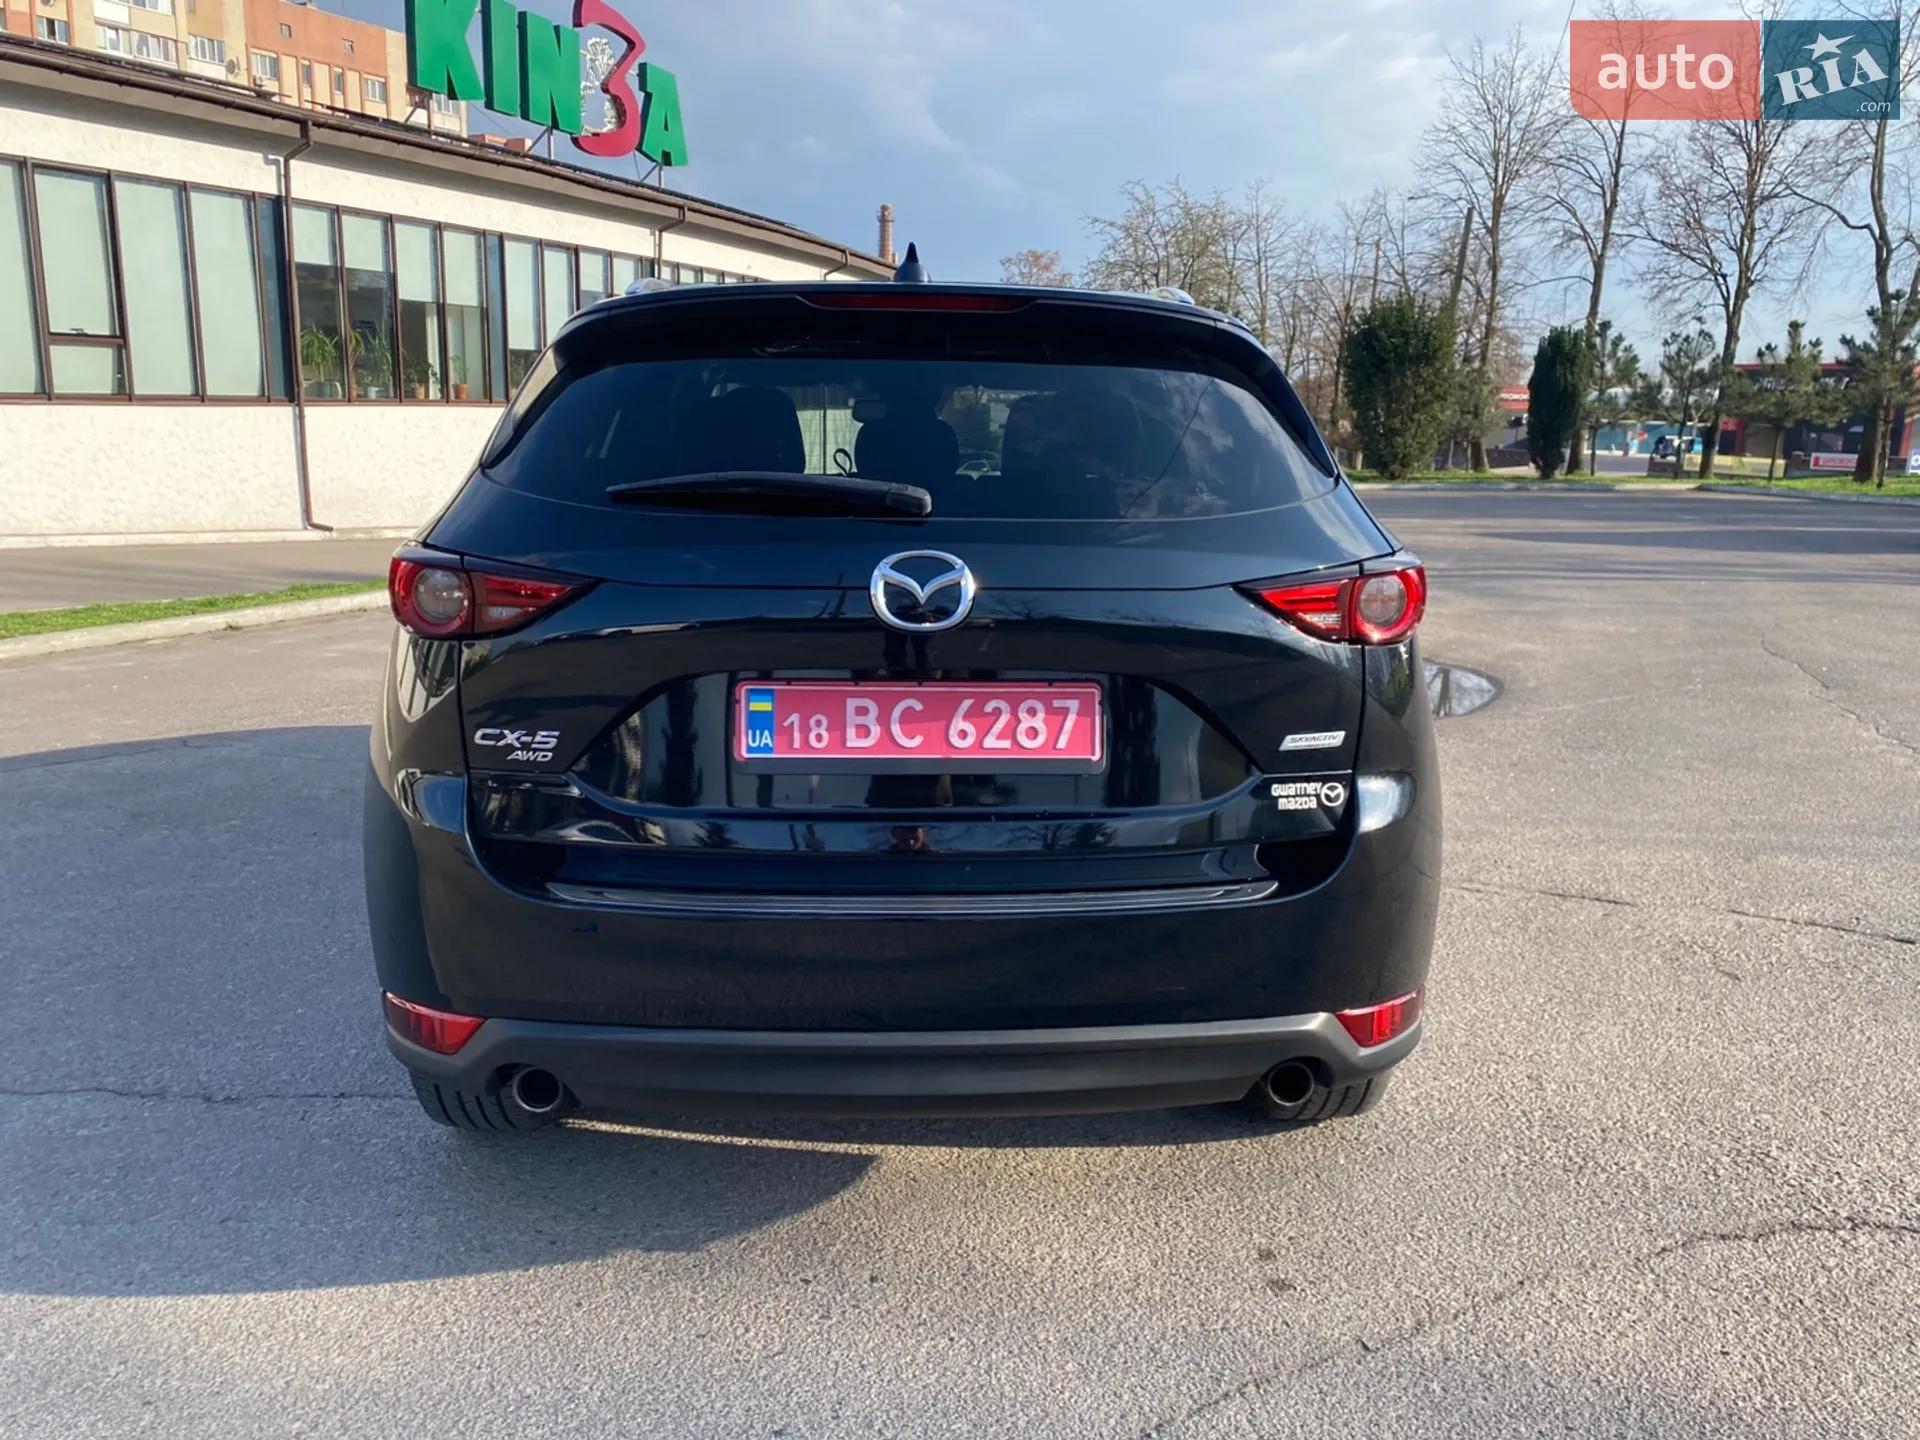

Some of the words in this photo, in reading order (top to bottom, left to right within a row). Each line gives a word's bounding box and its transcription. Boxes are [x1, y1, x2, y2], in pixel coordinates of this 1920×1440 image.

[782, 712, 829, 749] 18
[845, 697, 925, 749] BC
[949, 698, 1080, 750] 6287
[474, 728, 561, 749] CX-5
[748, 728, 773, 748] UA
[1288, 733, 1340, 744] SKYACTIV
[506, 750, 554, 762] AWD
